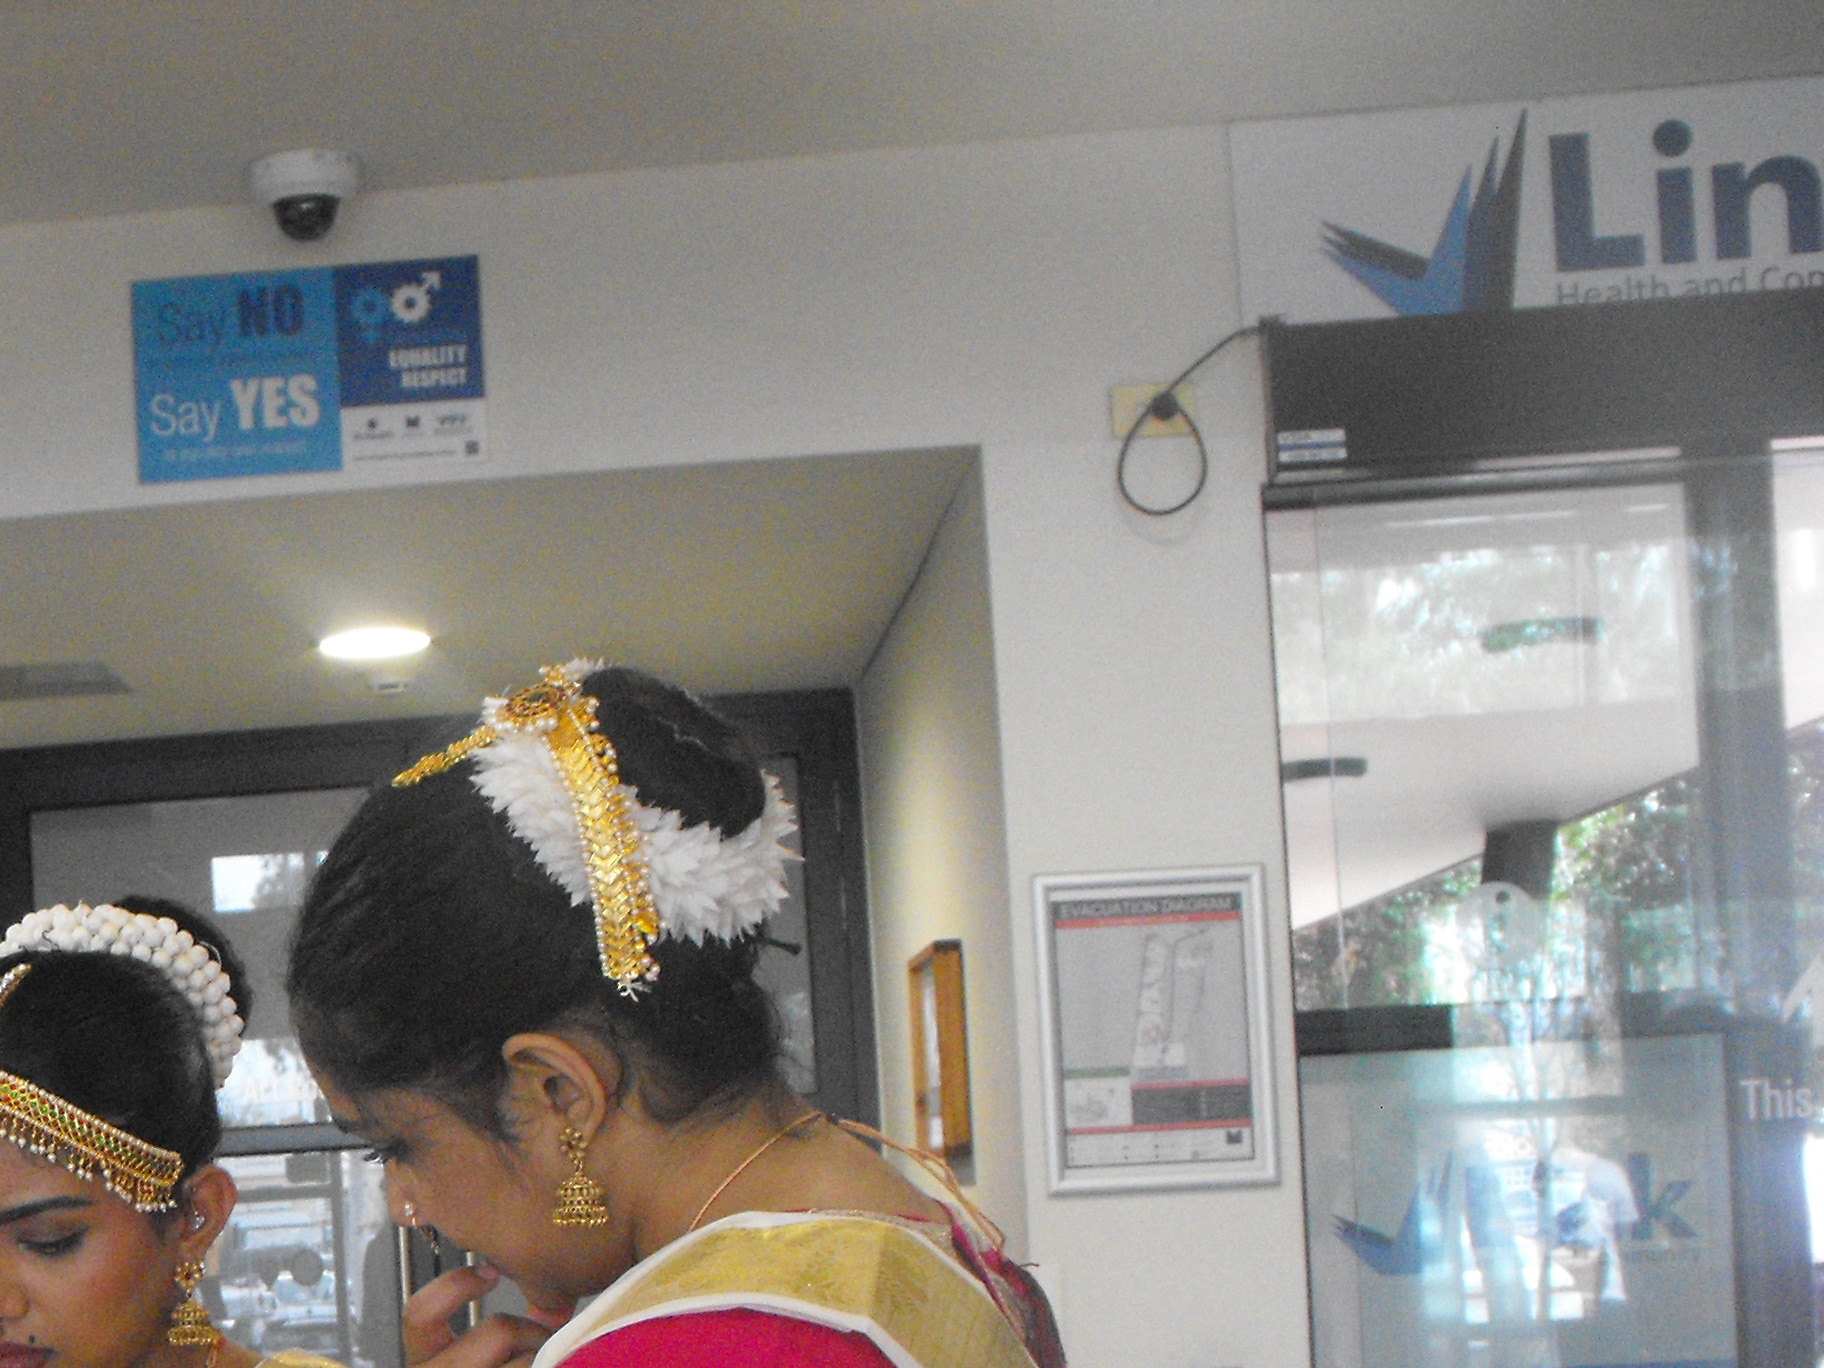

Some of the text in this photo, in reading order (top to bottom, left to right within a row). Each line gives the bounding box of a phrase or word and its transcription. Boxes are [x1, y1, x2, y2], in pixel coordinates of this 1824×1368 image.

[1557, 274, 1671, 305] Health
[1684, 267, 1747, 295] and
[157, 284, 305, 350] Say NO
[151, 373, 321, 442] Say YES
[1061, 897, 1232, 918] EVACUATION DIAGRAM
[1738, 1077, 1814, 1120] This
